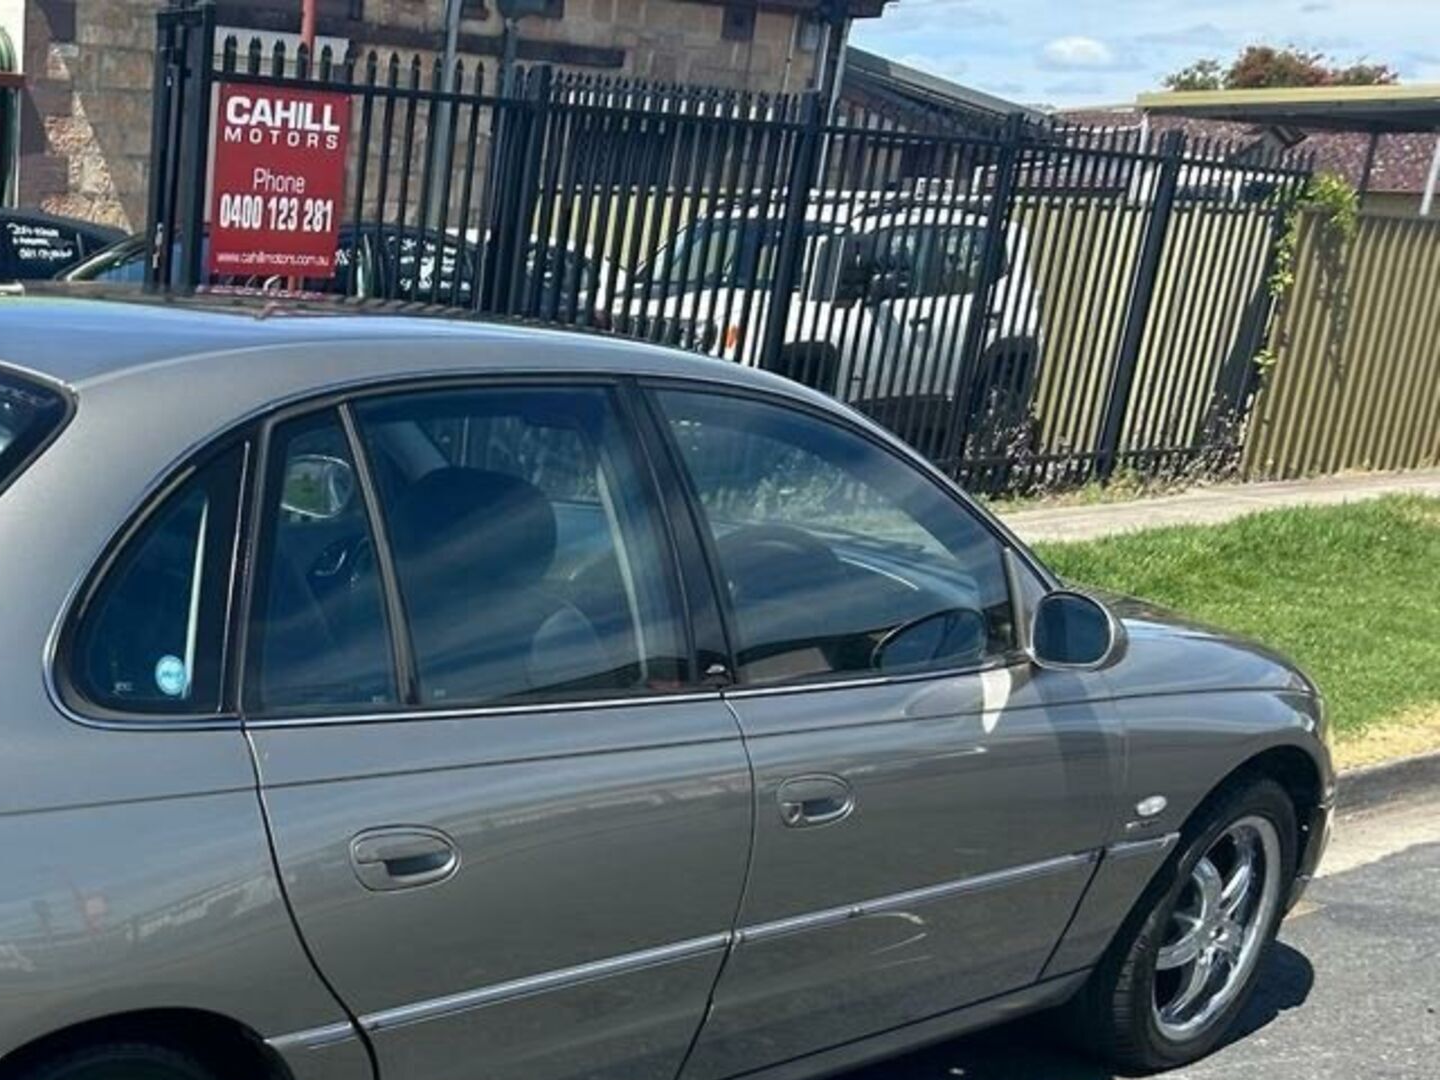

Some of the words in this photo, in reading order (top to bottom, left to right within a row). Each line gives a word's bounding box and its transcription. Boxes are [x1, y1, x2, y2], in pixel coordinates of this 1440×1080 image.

[226, 95, 340, 132] CAHILL
[224, 126, 339, 150] MOTORS
[253, 167, 305, 194] Phone
[220, 193, 262, 229] 0400
[267, 196, 299, 231] 123
[303, 198, 334, 233] 281
